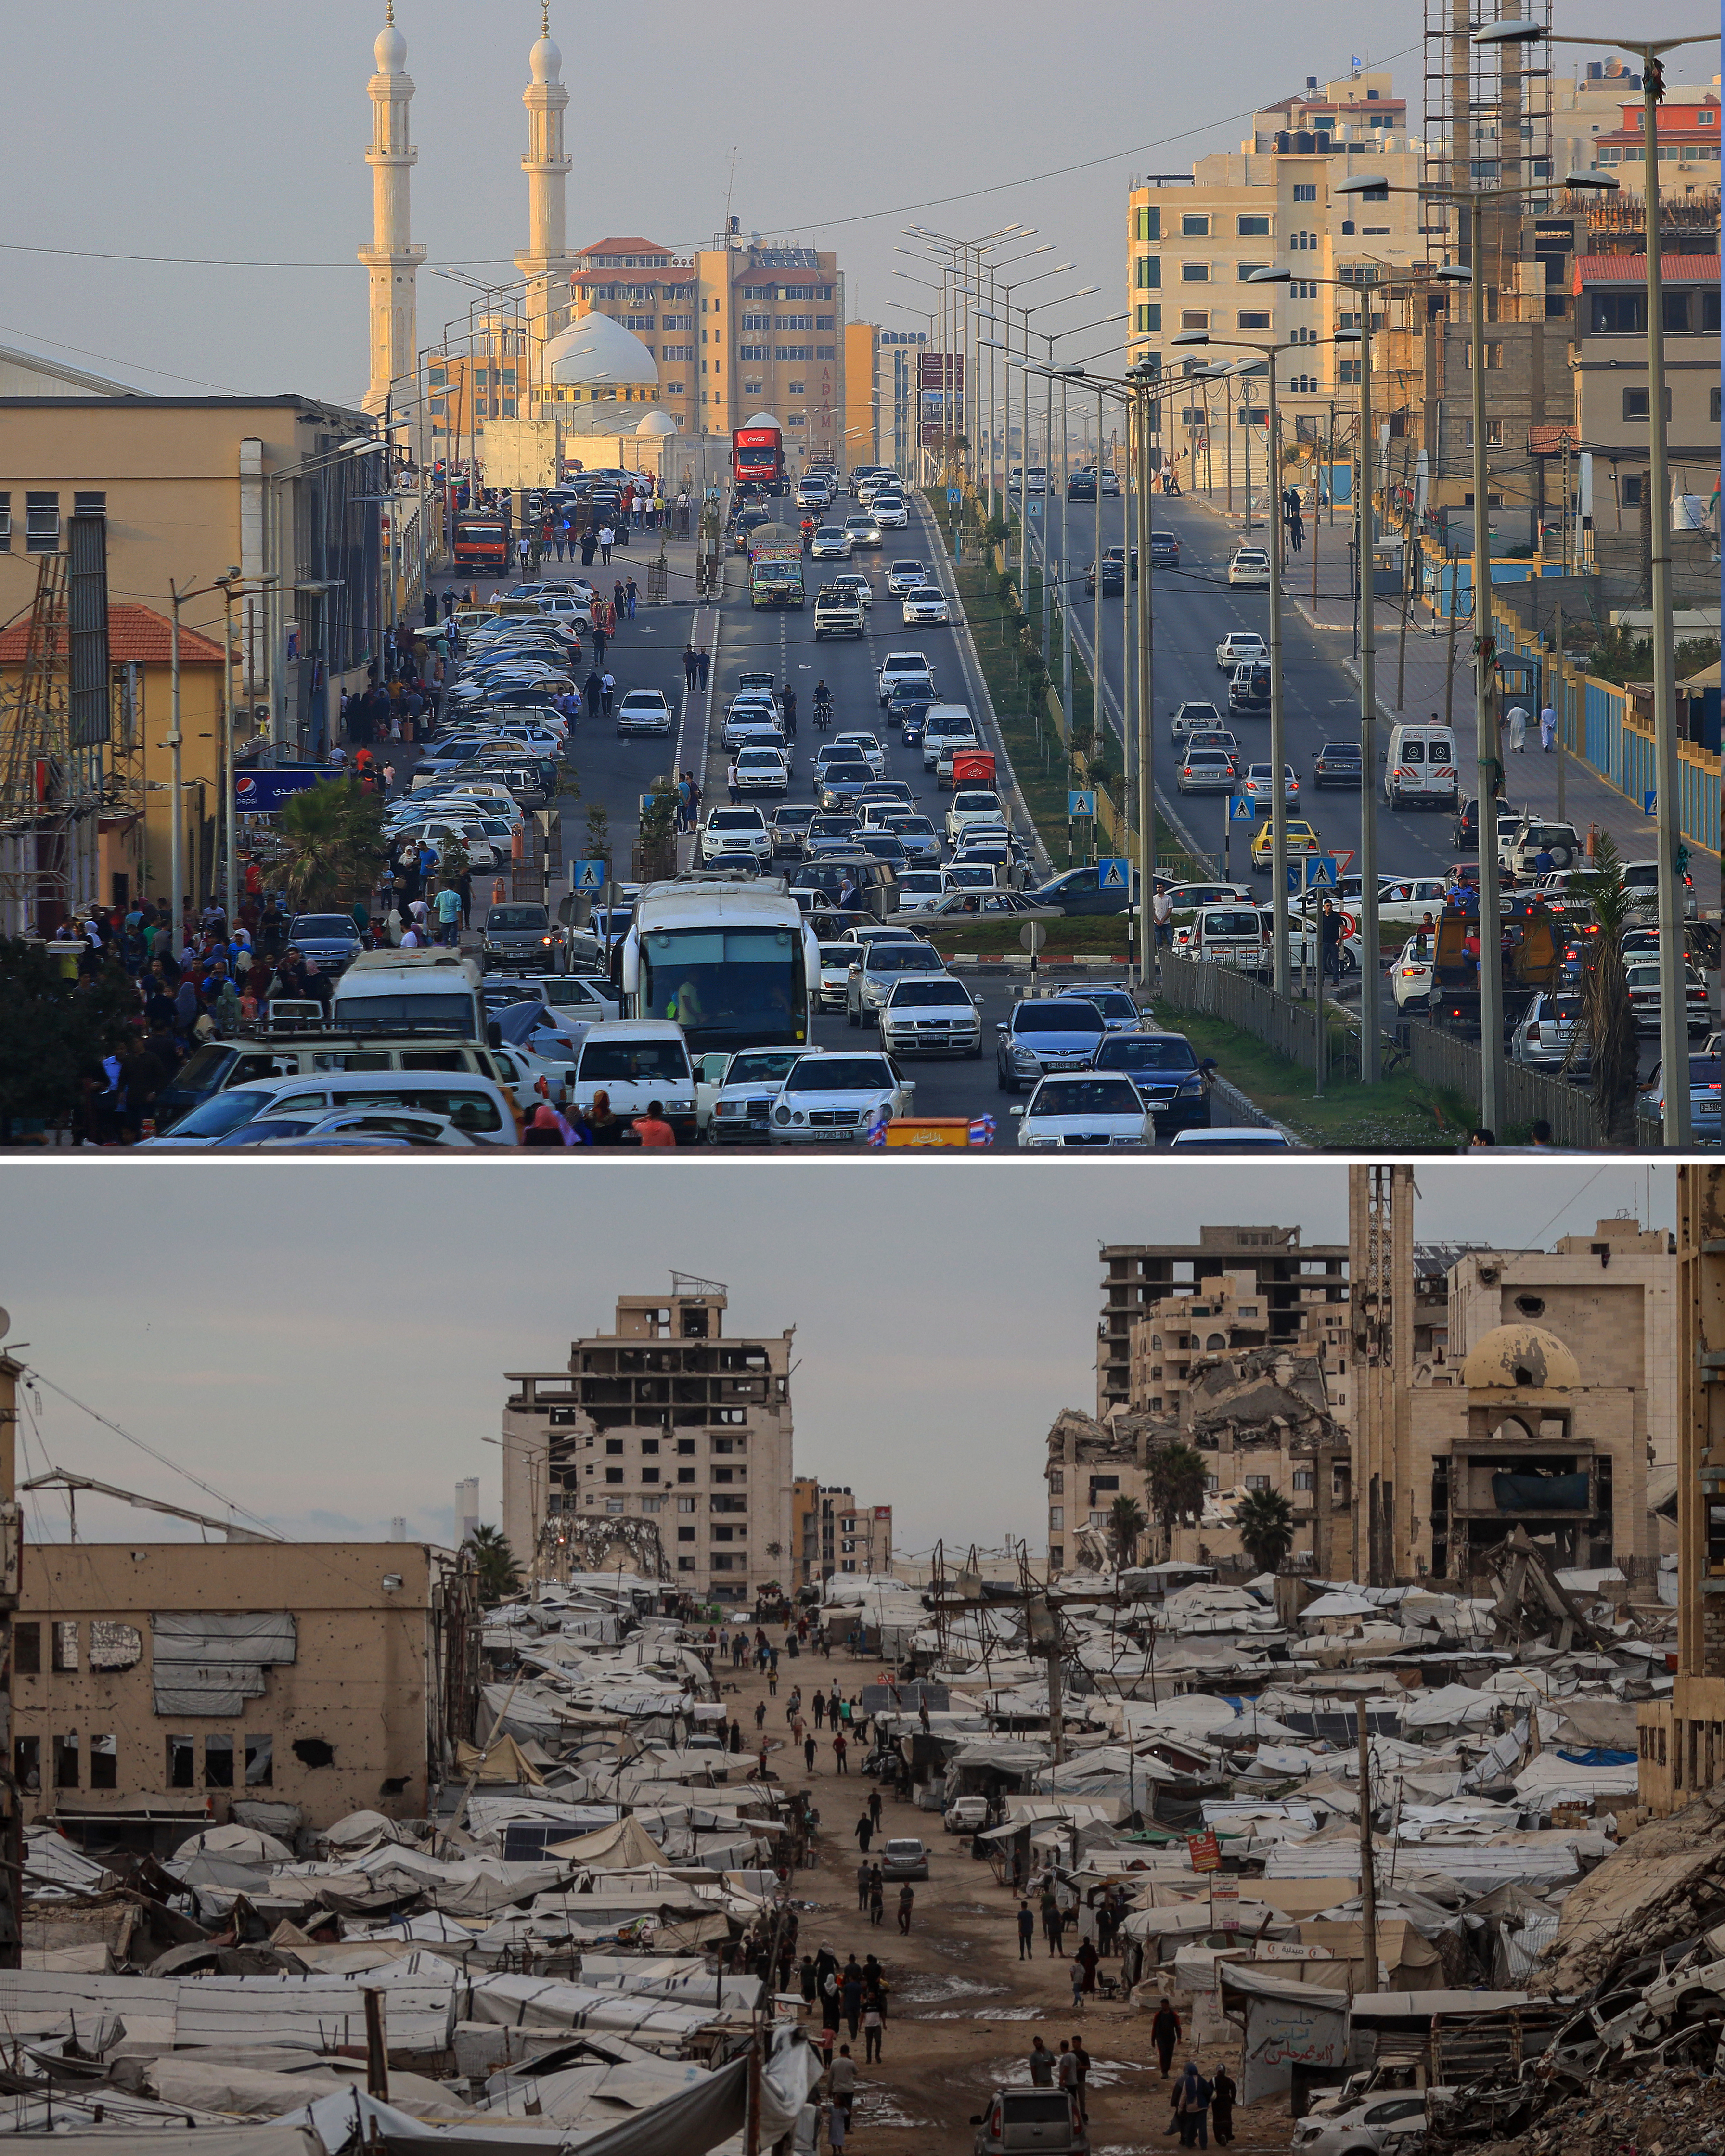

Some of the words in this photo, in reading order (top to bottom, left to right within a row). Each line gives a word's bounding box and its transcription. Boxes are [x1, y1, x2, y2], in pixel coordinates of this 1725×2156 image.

[821, 366, 832, 428] ADAM
[236, 797, 257, 806] pepsi
[1282, 1946, 1304, 1954] صيدلية
